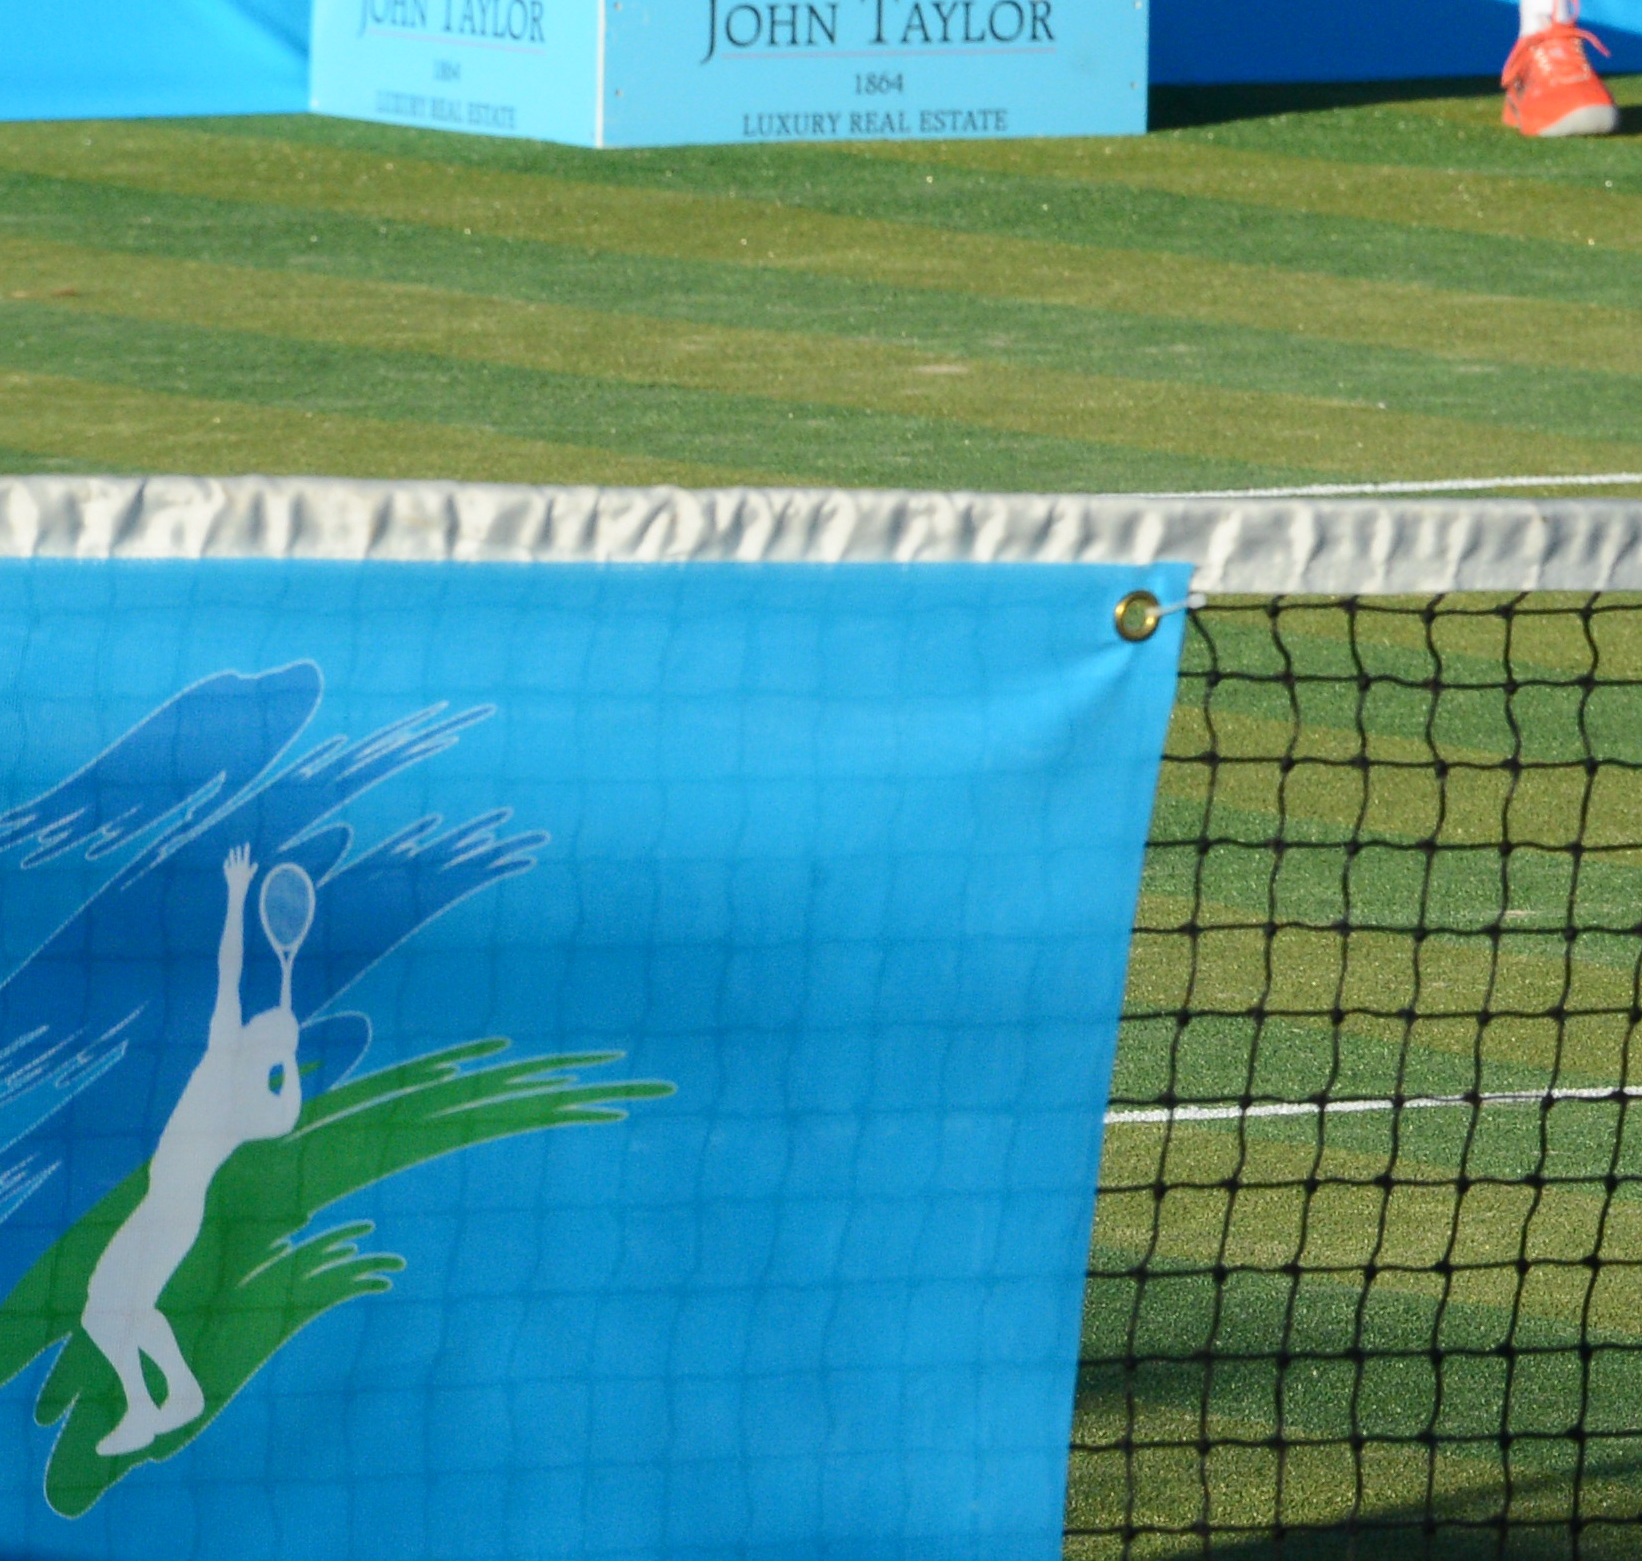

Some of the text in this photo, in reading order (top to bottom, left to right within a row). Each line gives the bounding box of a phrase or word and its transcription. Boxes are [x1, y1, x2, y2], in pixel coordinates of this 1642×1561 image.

[854, 71, 905, 95] 1864
[741, 107, 1009, 137] LUXURY REAL ESTATE
